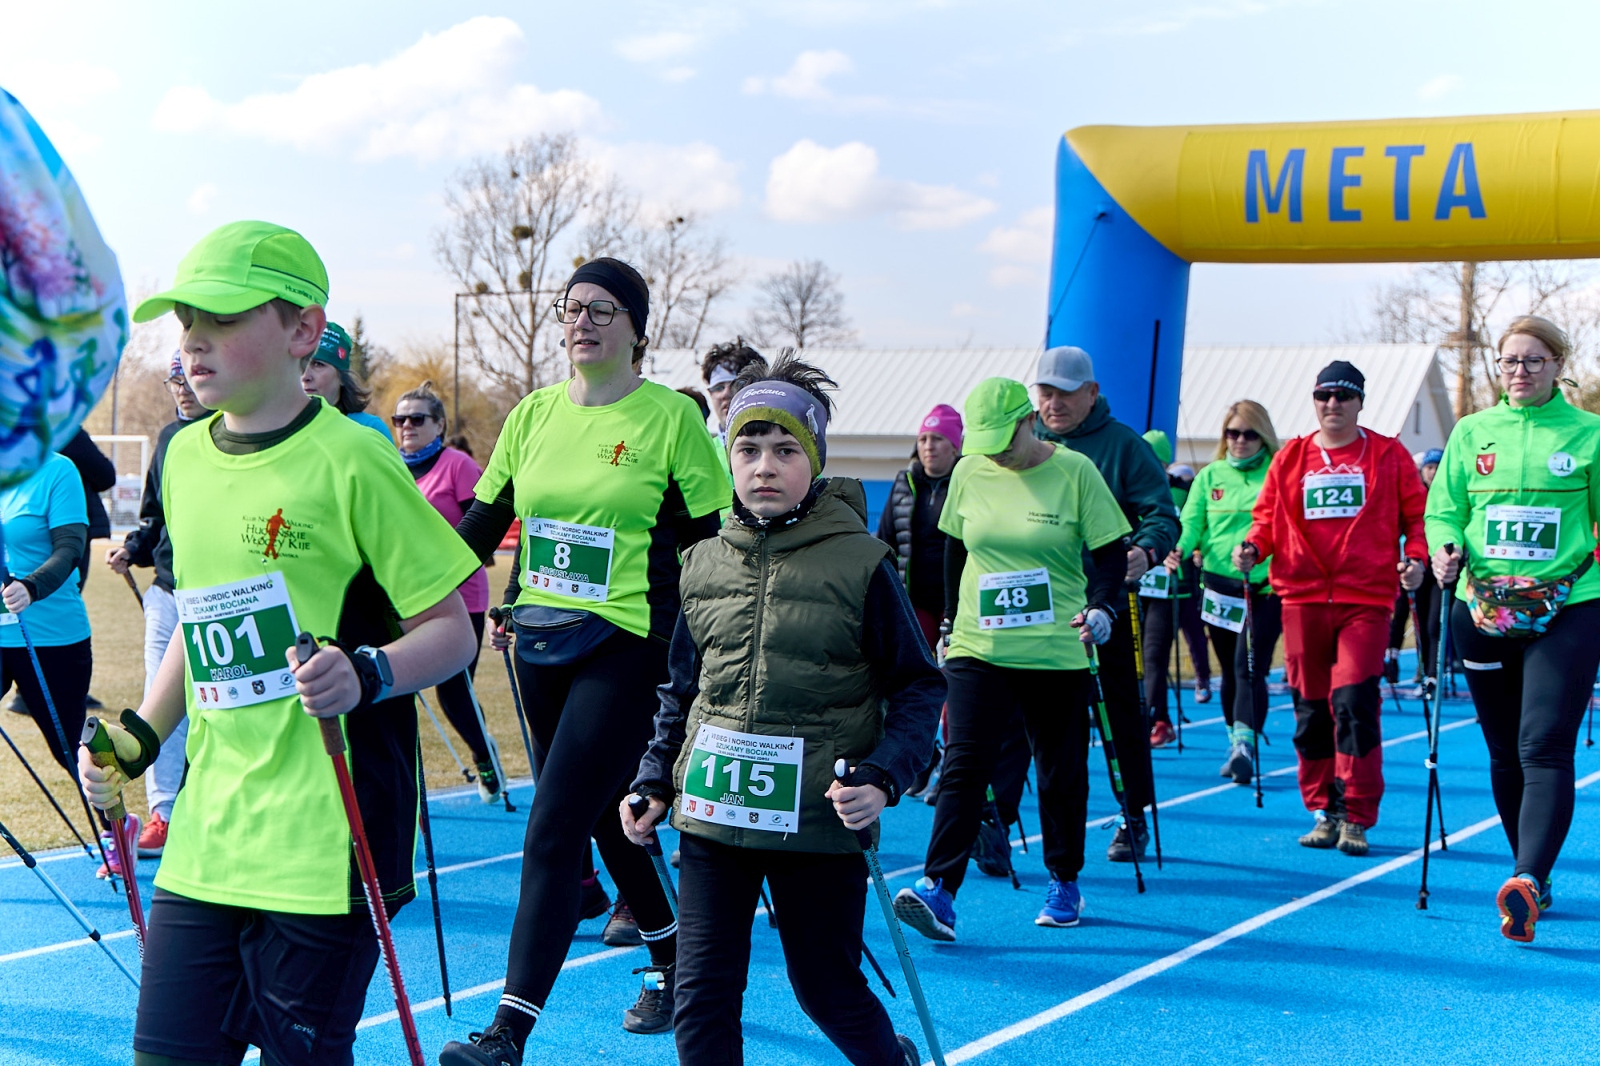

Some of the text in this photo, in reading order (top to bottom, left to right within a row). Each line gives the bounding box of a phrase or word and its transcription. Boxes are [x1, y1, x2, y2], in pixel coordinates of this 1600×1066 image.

[1244, 142, 1487, 223] META
[742, 388, 787, 400] Bociana
[1313, 488, 1354, 506] 124
[571, 534, 597, 542] BOCIANA
[582, 529, 608, 538] WALKING
[1496, 520, 1545, 541] 117
[553, 542, 571, 569] 8
[203, 591, 231, 603] NORDIC
[231, 581, 273, 597] WALKING
[994, 587, 1029, 608] 48
[220, 595, 259, 611] BOCIANA
[1211, 602, 1232, 616] 37
[191, 614, 265, 667] 101
[533, 641, 547, 651] 4F
[210, 663, 253, 681] KAROL
[715, 742, 779, 757] SZUKAMY BOCIANA
[731, 738, 758, 748] NORDIC
[759, 742, 793, 751] WALKING
[701, 754, 775, 797] 115
[719, 793, 745, 806] JAN
